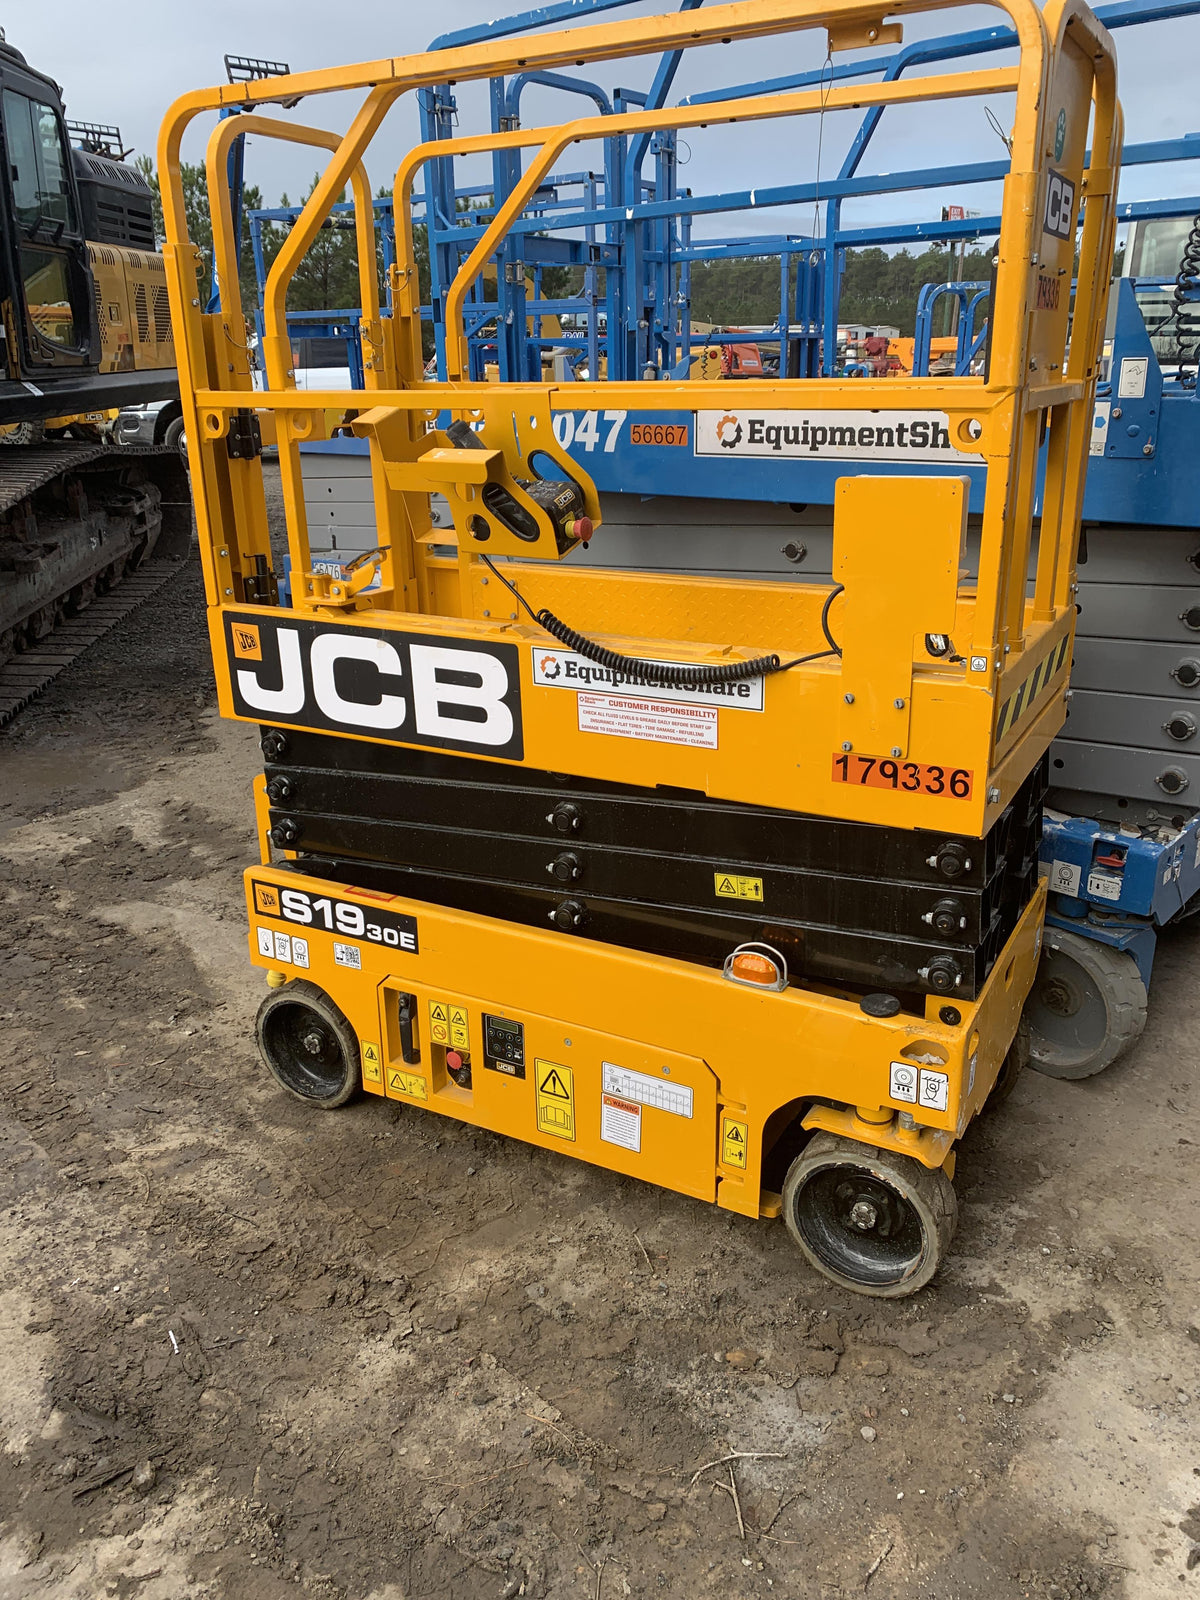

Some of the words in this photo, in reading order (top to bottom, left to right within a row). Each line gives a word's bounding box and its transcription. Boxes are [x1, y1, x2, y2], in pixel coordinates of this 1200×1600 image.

[1037, 275, 1060, 309] 79336
[86, 413, 103, 421] JCB
[552, 410, 628, 453] 047
[632, 425, 687, 445] 56667
[748, 419, 952, 452] EquipmentSh
[559, 491, 573, 506] JCB
[240, 631, 257, 650] JCB
[237, 627, 514, 746] JCB
[608, 700, 649, 711] CUSTOMER
[651, 704, 716, 719] RESPONSIBILITY
[590, 718, 615, 726] INSURANCE
[656, 726, 675, 734] DAMAGE
[678, 729, 704, 737] REFUELING
[606, 727, 632, 735] EQUIPMENT
[655, 733, 688, 743] MAINTENANCE
[690, 738, 715, 746] CLEANING
[836, 755, 970, 798] 179336
[262, 891, 276, 906] JCB
[497, 1062, 515, 1073] JCB
[613, 1100, 638, 1114] WARNING
